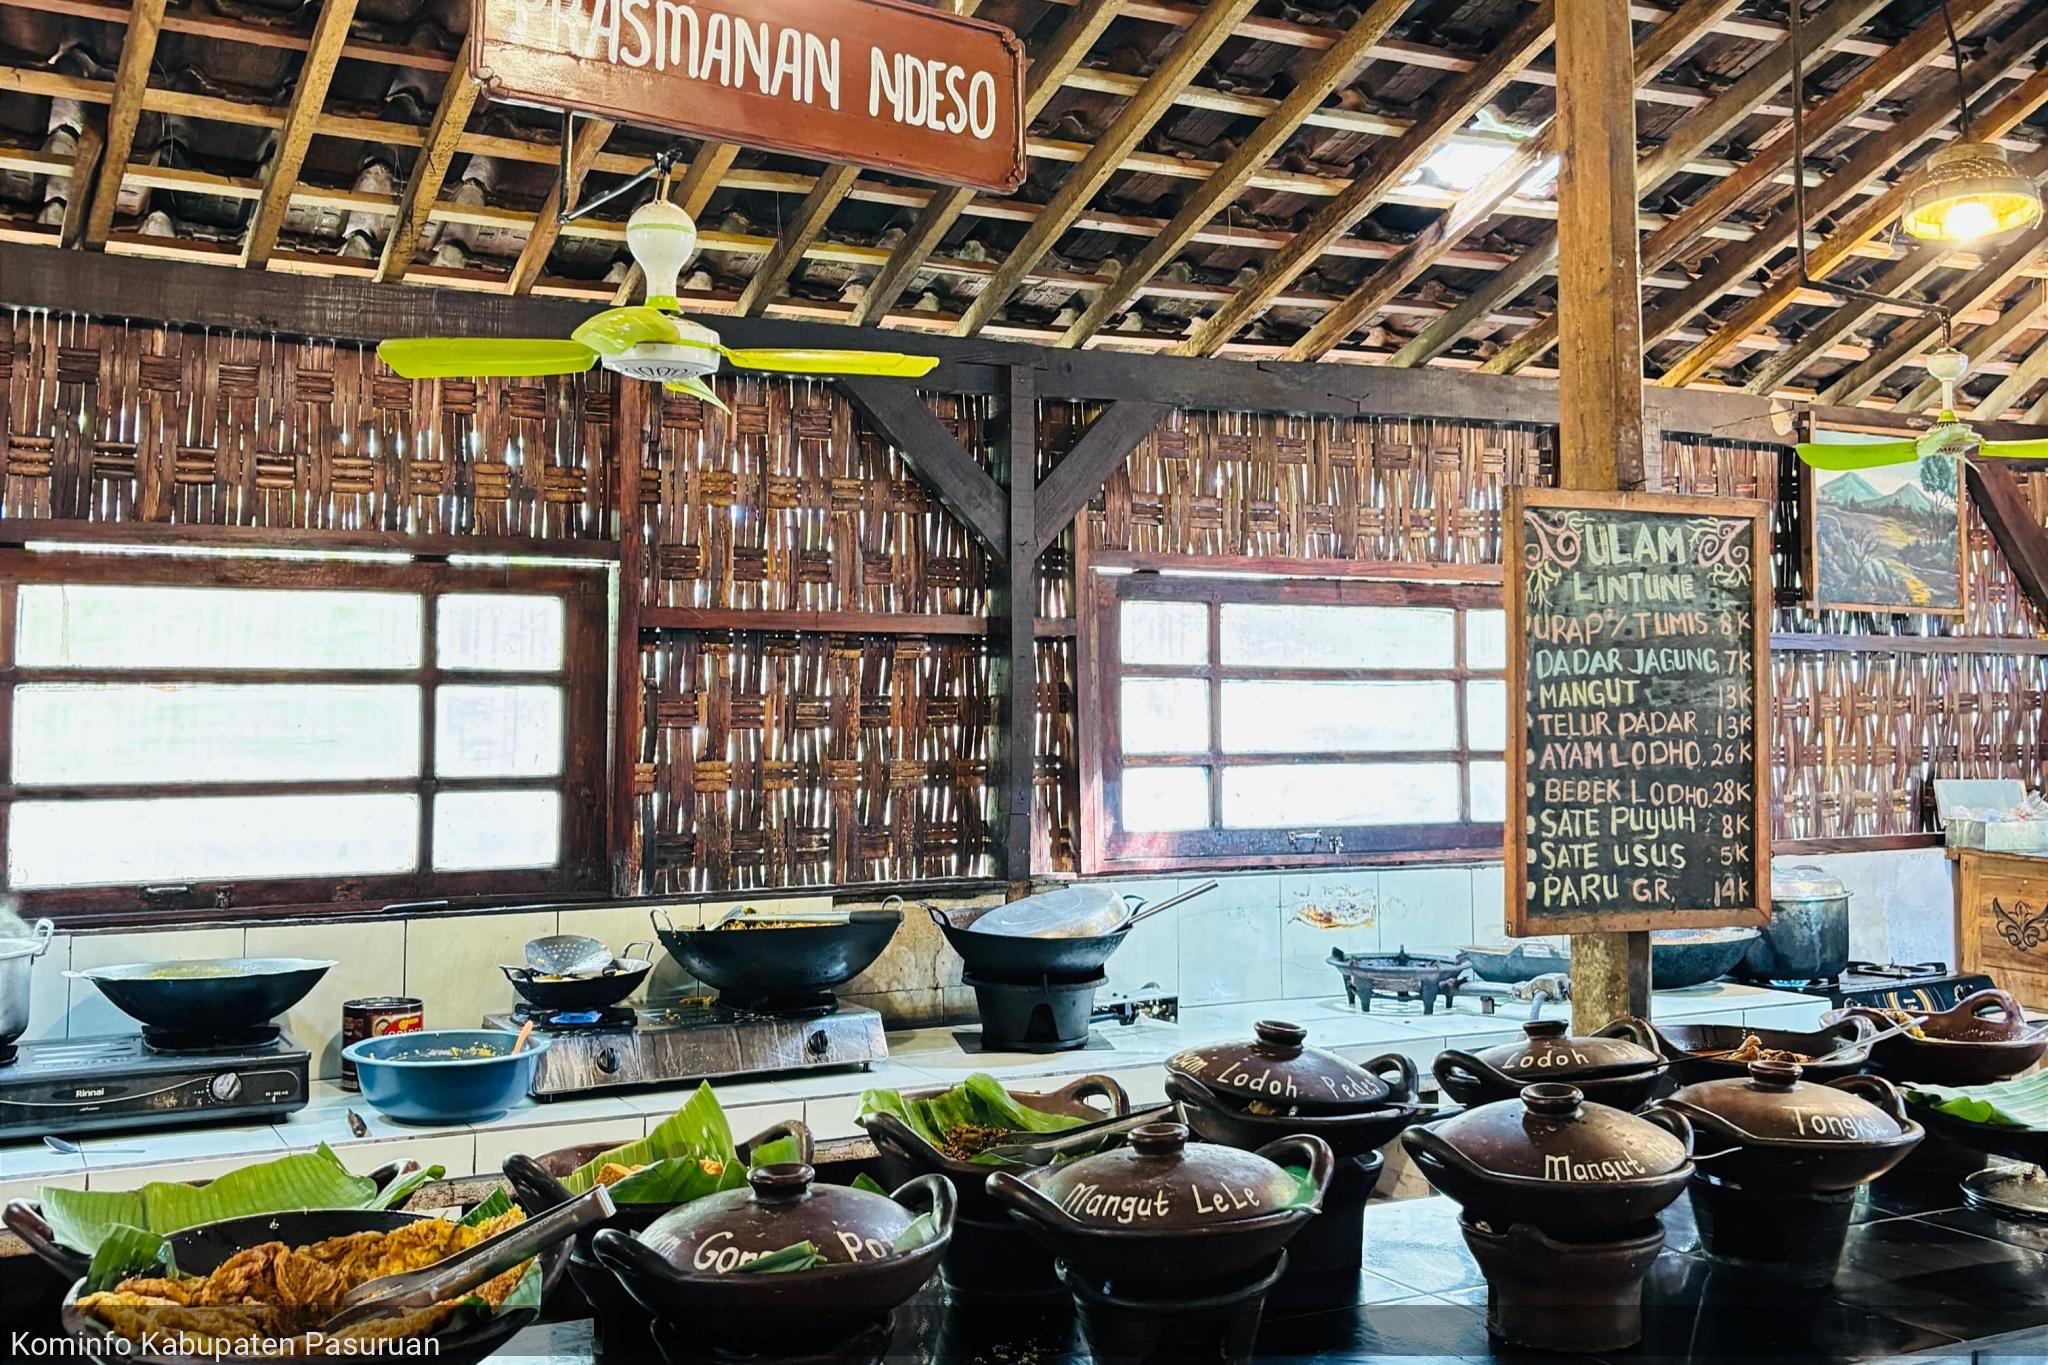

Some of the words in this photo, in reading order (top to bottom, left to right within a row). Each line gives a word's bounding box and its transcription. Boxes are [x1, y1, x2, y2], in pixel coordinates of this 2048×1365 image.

[869, 46, 996, 140] NDESO
[1584, 522, 1686, 566] ULAM
[1572, 571, 1697, 603] LINTUNE
[1536, 648, 1623, 680] DADAR
[1540, 678, 1641, 709] MANGUT
[1717, 683, 1752, 710] 13K
[1537, 711, 1613, 738] TELUR
[1539, 741, 1604, 770] AYAM
[1711, 742, 1752, 767] 26K
[1544, 778, 1621, 804] BEBEK
[1712, 778, 1752, 805] 28K
[1540, 808, 1600, 838] SATE
[1541, 842, 1599, 870] SATE
[1543, 874, 1620, 907] PARU
[1501, 1048, 1590, 1070] Lodoh
[75, 1087, 105, 1098] Rinnai
[1216, 1062, 1298, 1099] Lodoh
[1544, 1150, 1646, 1182] Mangut
[1061, 1182, 1170, 1224] Mangut
